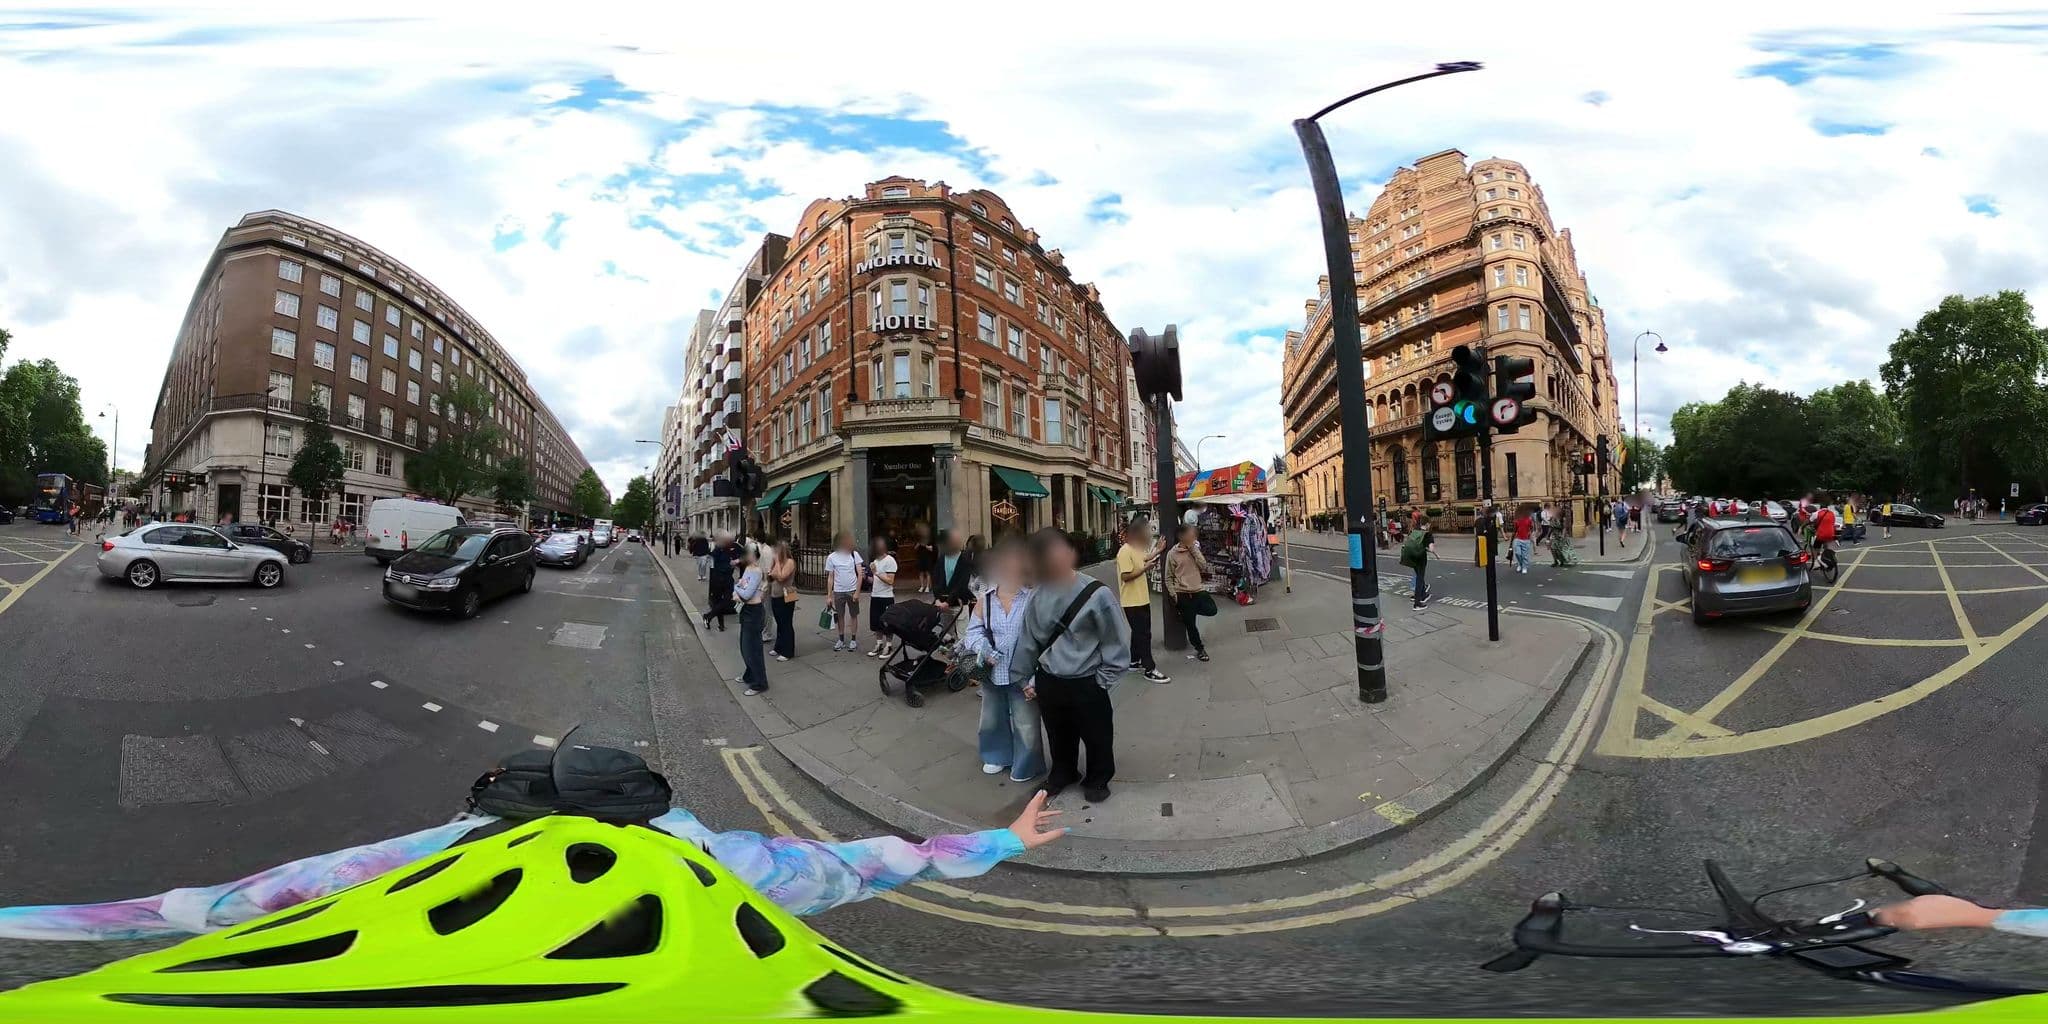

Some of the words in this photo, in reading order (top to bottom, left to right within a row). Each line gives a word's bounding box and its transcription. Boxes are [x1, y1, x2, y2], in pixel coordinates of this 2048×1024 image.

[856, 254, 941, 274] MORTON
[872, 315, 935, 332] HOTEL
[883, 462, 908, 470] Number
[1437, 596, 1487, 609] RIGHT
